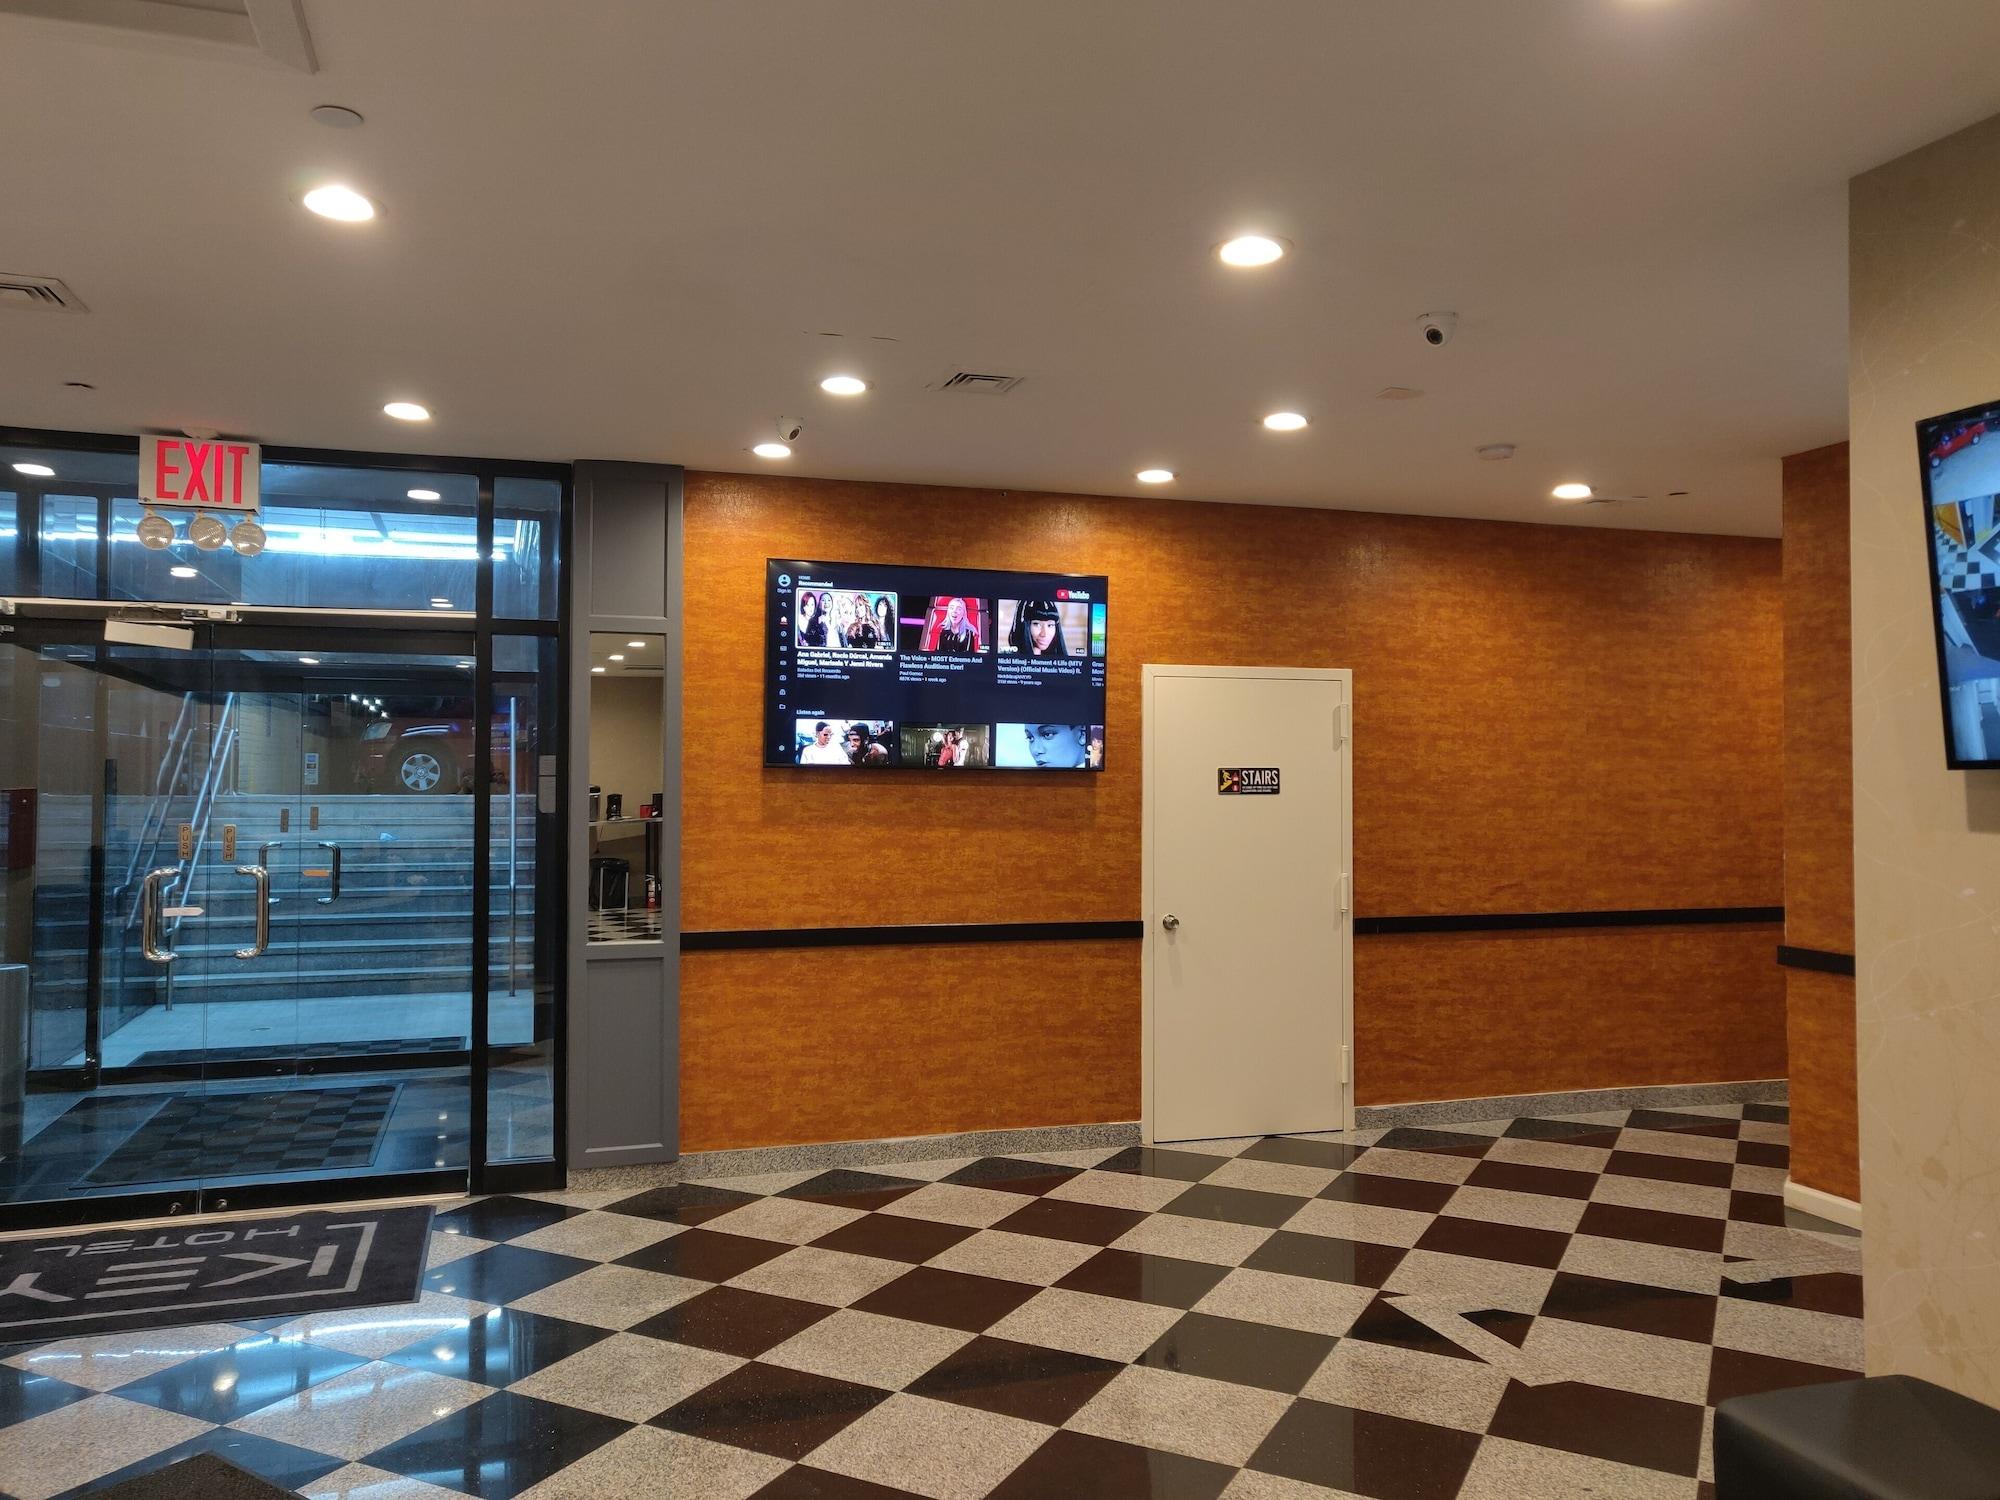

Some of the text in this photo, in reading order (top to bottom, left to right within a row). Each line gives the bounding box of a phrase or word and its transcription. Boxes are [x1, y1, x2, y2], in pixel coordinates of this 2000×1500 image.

[155, 440, 250, 504] EXIT
[1068, 590, 1090, 600] YouTube
[1242, 770, 1278, 785] STAIRS
[35, 1224, 299, 1258] HOTEL
